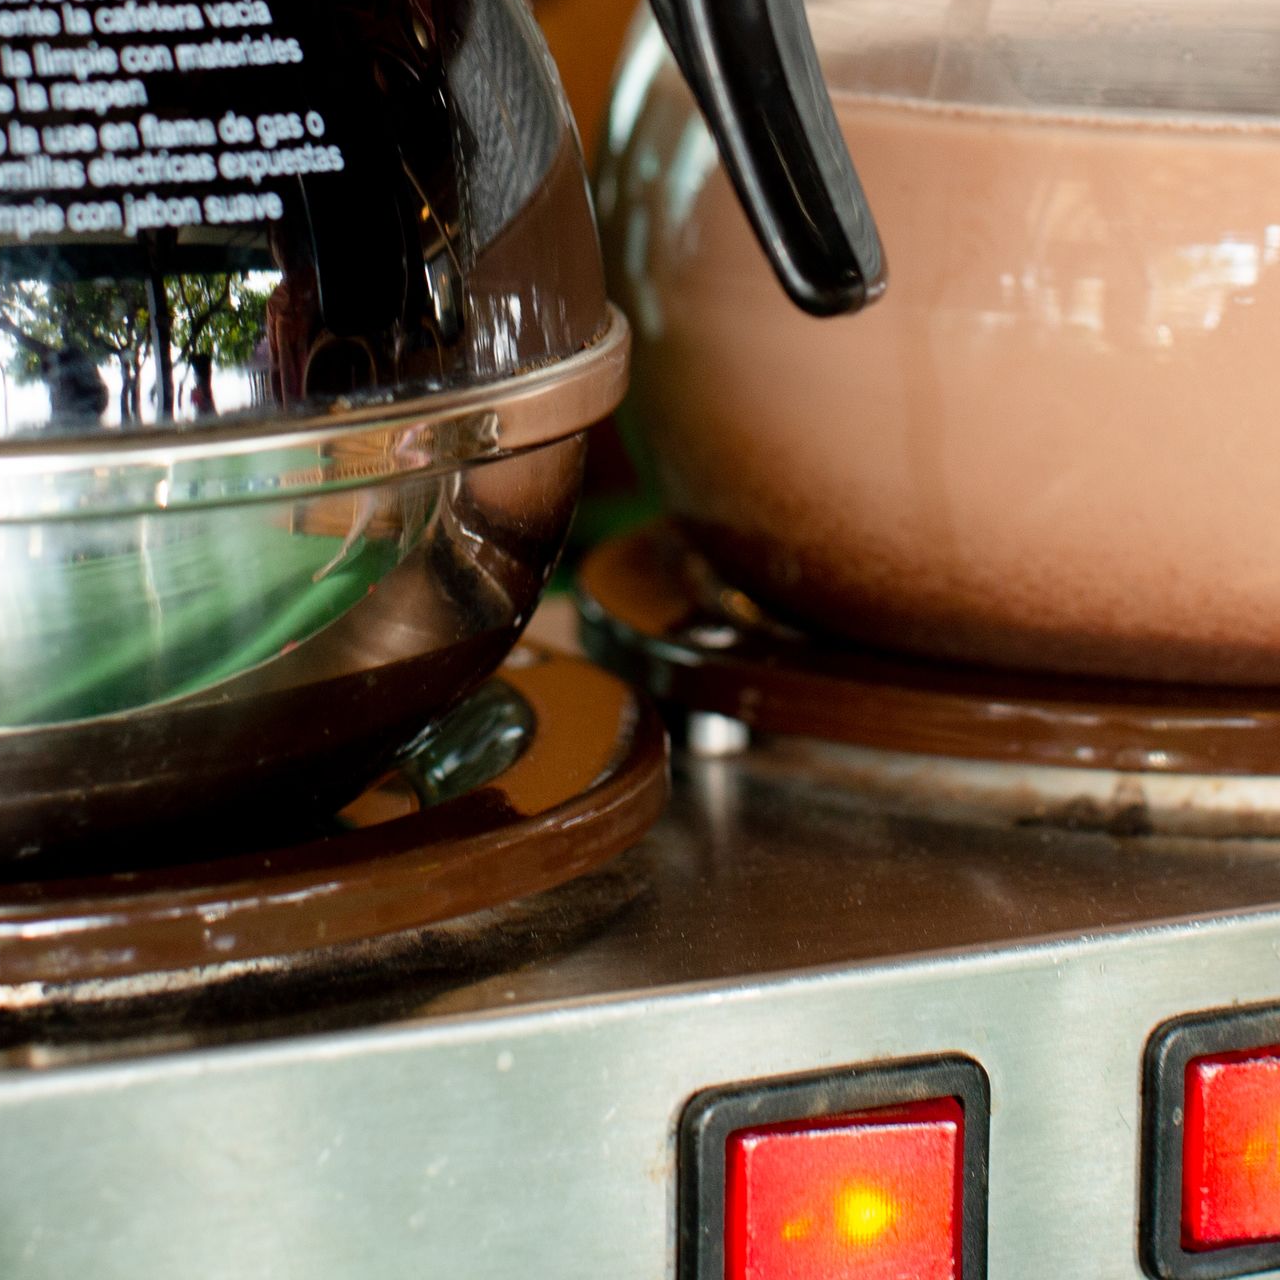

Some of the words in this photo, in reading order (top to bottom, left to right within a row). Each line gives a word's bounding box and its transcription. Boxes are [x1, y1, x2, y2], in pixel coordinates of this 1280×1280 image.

[62, 1, 93, 35] la
[93, 0, 205, 35] cafetera
[0, 43, 34, 78] la
[32, 40, 119, 81] limpie
[120, 44, 175, 74] con
[174, 33, 304, 71] materiales
[15, 78, 49, 112] la
[49, 78, 148, 116] raspen
[7, 119, 41, 156] la
[41, 122, 98, 154] use
[98, 122, 140, 152] en
[218, 110, 255, 144] de
[255, 113, 305, 149] gas
[304, 110, 325, 137] o
[218, 141, 346, 186] expuestas
[66, 200, 123, 232] con
[203, 191, 284, 225] suave
